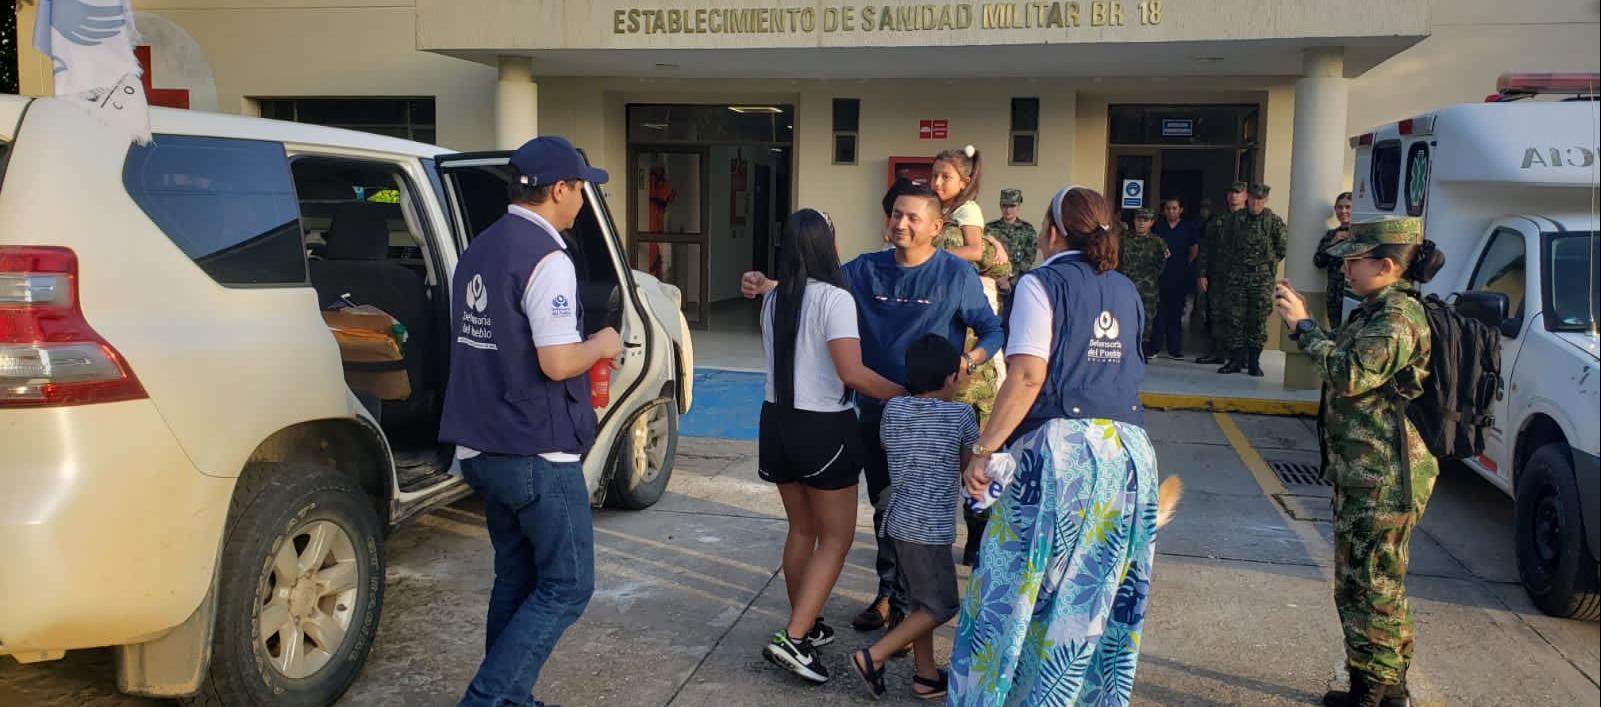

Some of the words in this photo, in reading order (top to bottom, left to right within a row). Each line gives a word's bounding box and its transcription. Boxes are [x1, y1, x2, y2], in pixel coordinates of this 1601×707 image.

[613, 7, 816, 35] ESTABLECIMIENTO
[823, 7, 855, 33] DE
[861, 4, 973, 32] SANIDAD
[982, 1, 1081, 30] MILITAR
[1090, 0, 1125, 27] BR
[1138, 0, 1163, 26] 18
